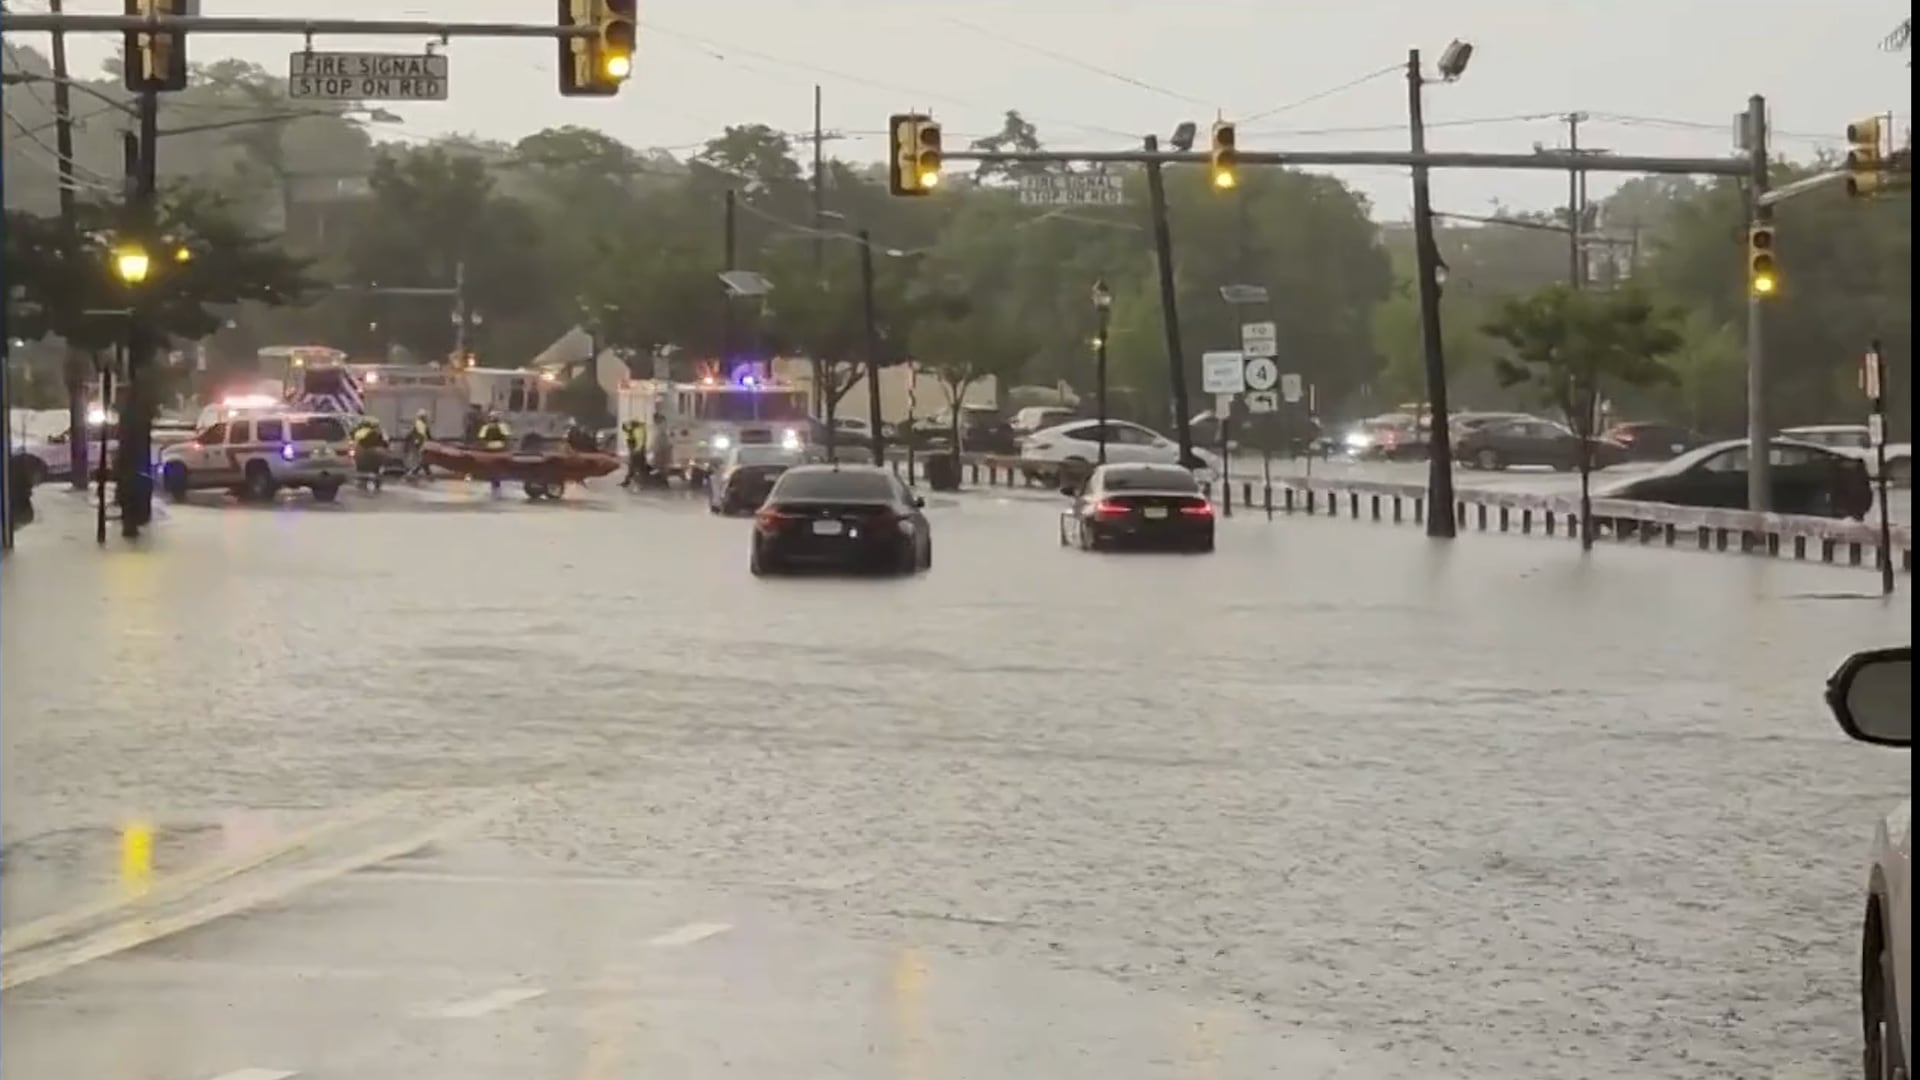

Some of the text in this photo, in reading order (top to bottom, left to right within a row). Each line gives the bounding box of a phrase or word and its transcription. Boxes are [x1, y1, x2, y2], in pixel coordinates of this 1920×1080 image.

[303, 56, 433, 76] FIRE SIGNAL
[300, 78, 439, 97] STOP ON RED
[1255, 364, 1268, 382] 4
